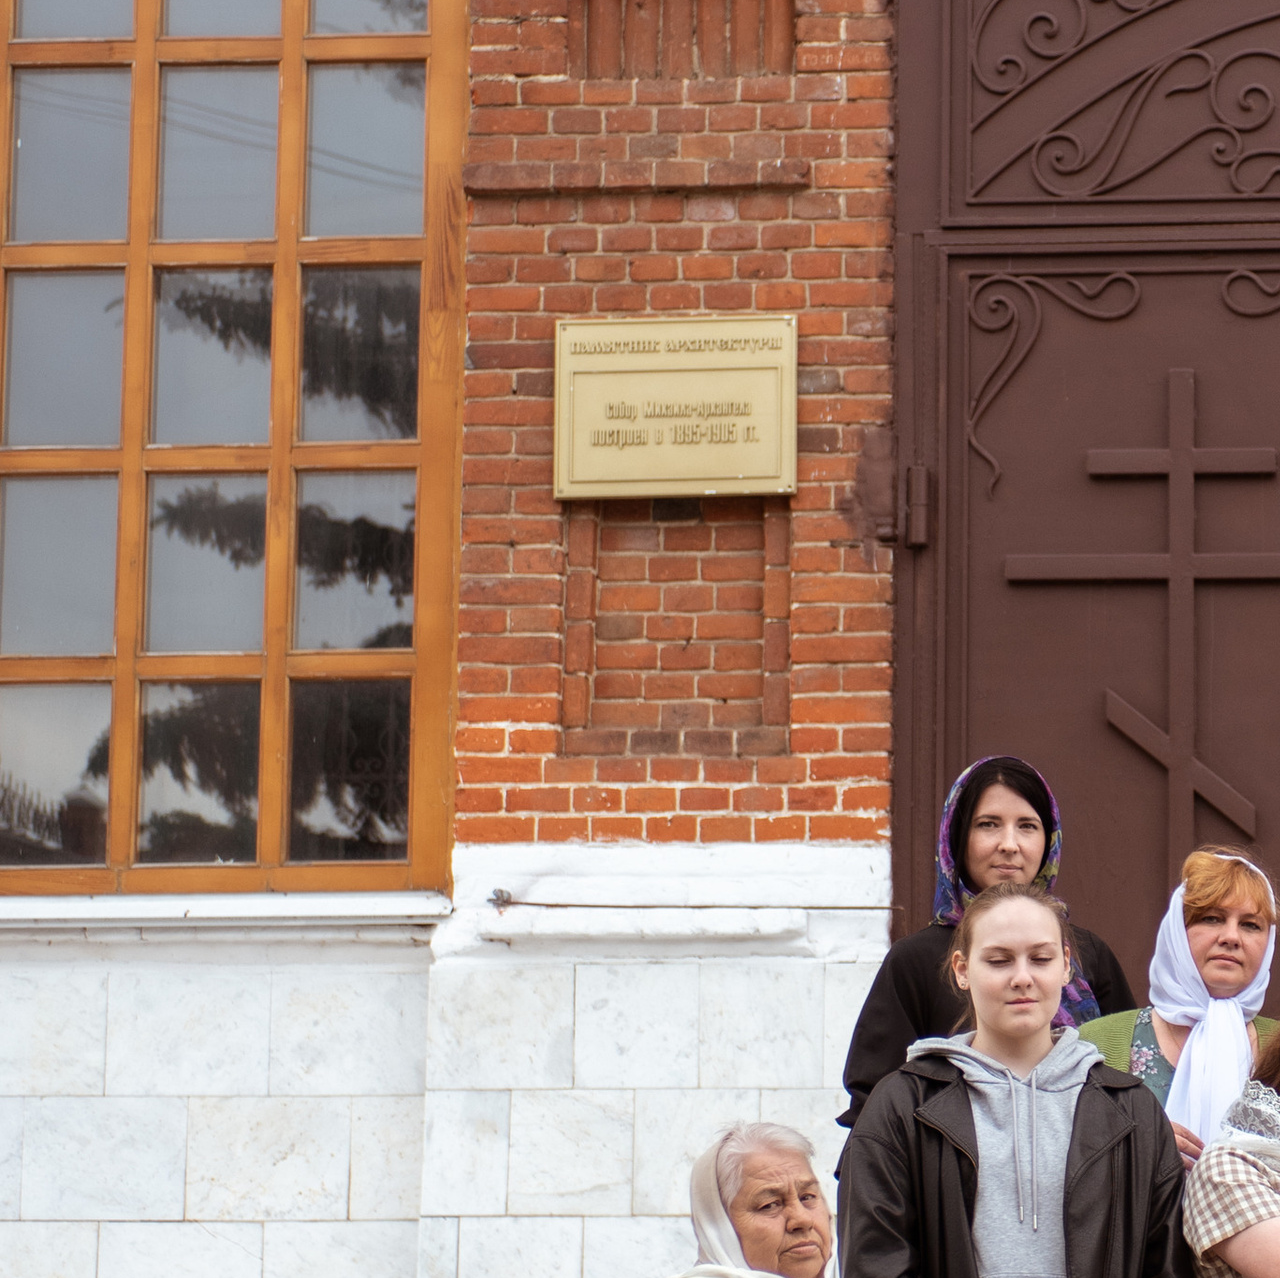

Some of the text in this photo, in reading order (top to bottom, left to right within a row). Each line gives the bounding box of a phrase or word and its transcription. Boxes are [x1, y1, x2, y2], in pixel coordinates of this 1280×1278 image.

[570, 337, 782, 355] ПАМЯТНИК АРХИТЕКТУРЫ
[605, 401, 638, 422] Собор
[591, 423, 760, 450] построен в 1895-1905 гг.
